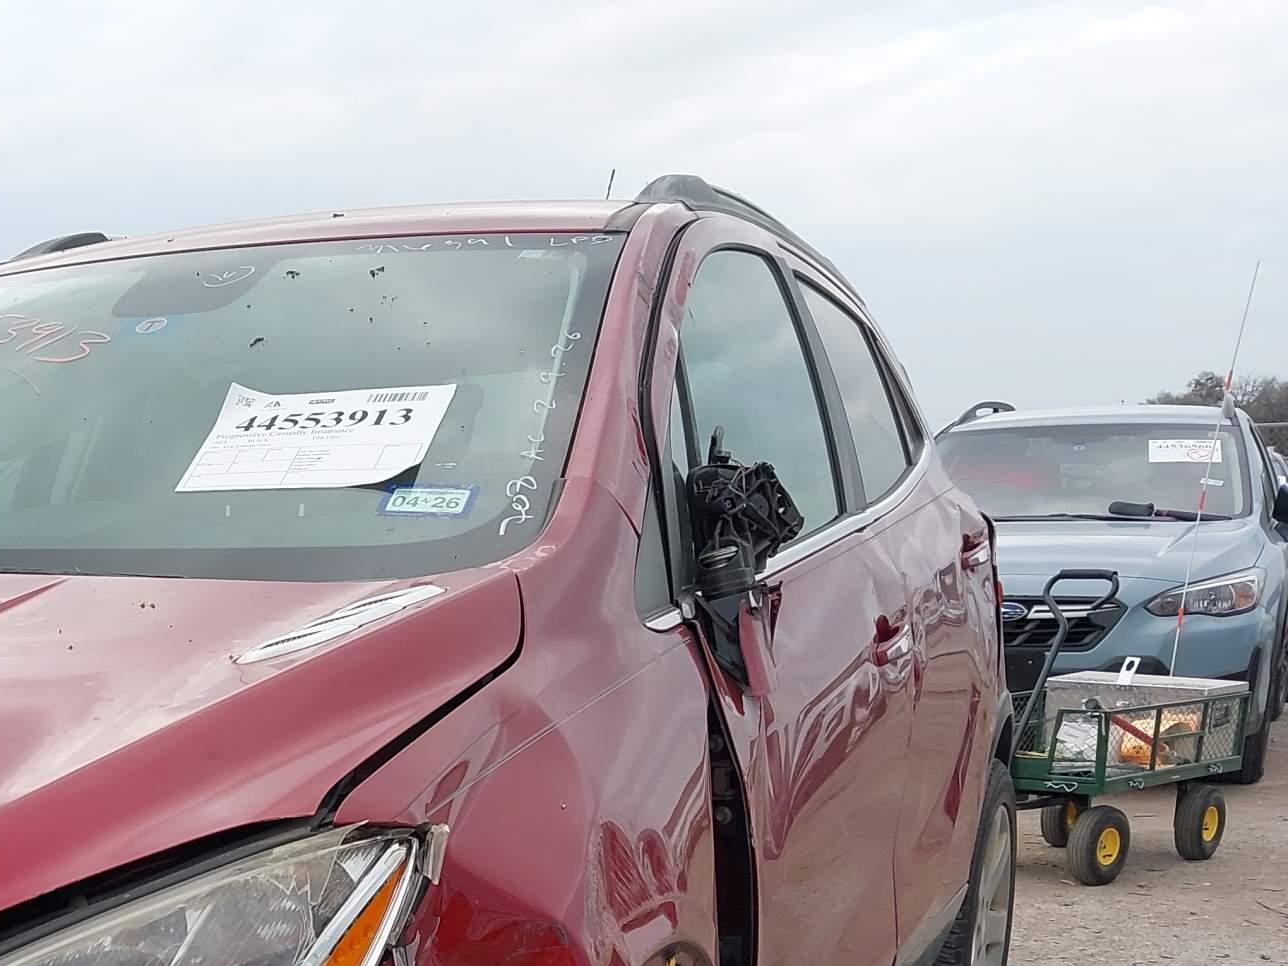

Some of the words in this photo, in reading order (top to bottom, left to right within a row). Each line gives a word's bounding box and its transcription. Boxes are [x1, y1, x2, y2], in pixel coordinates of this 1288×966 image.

[235, 408, 414, 432] 44553913
[310, 427, 356, 436] Insurance
[391, 495, 419, 508] 04
[430, 496, 461, 509] 26
